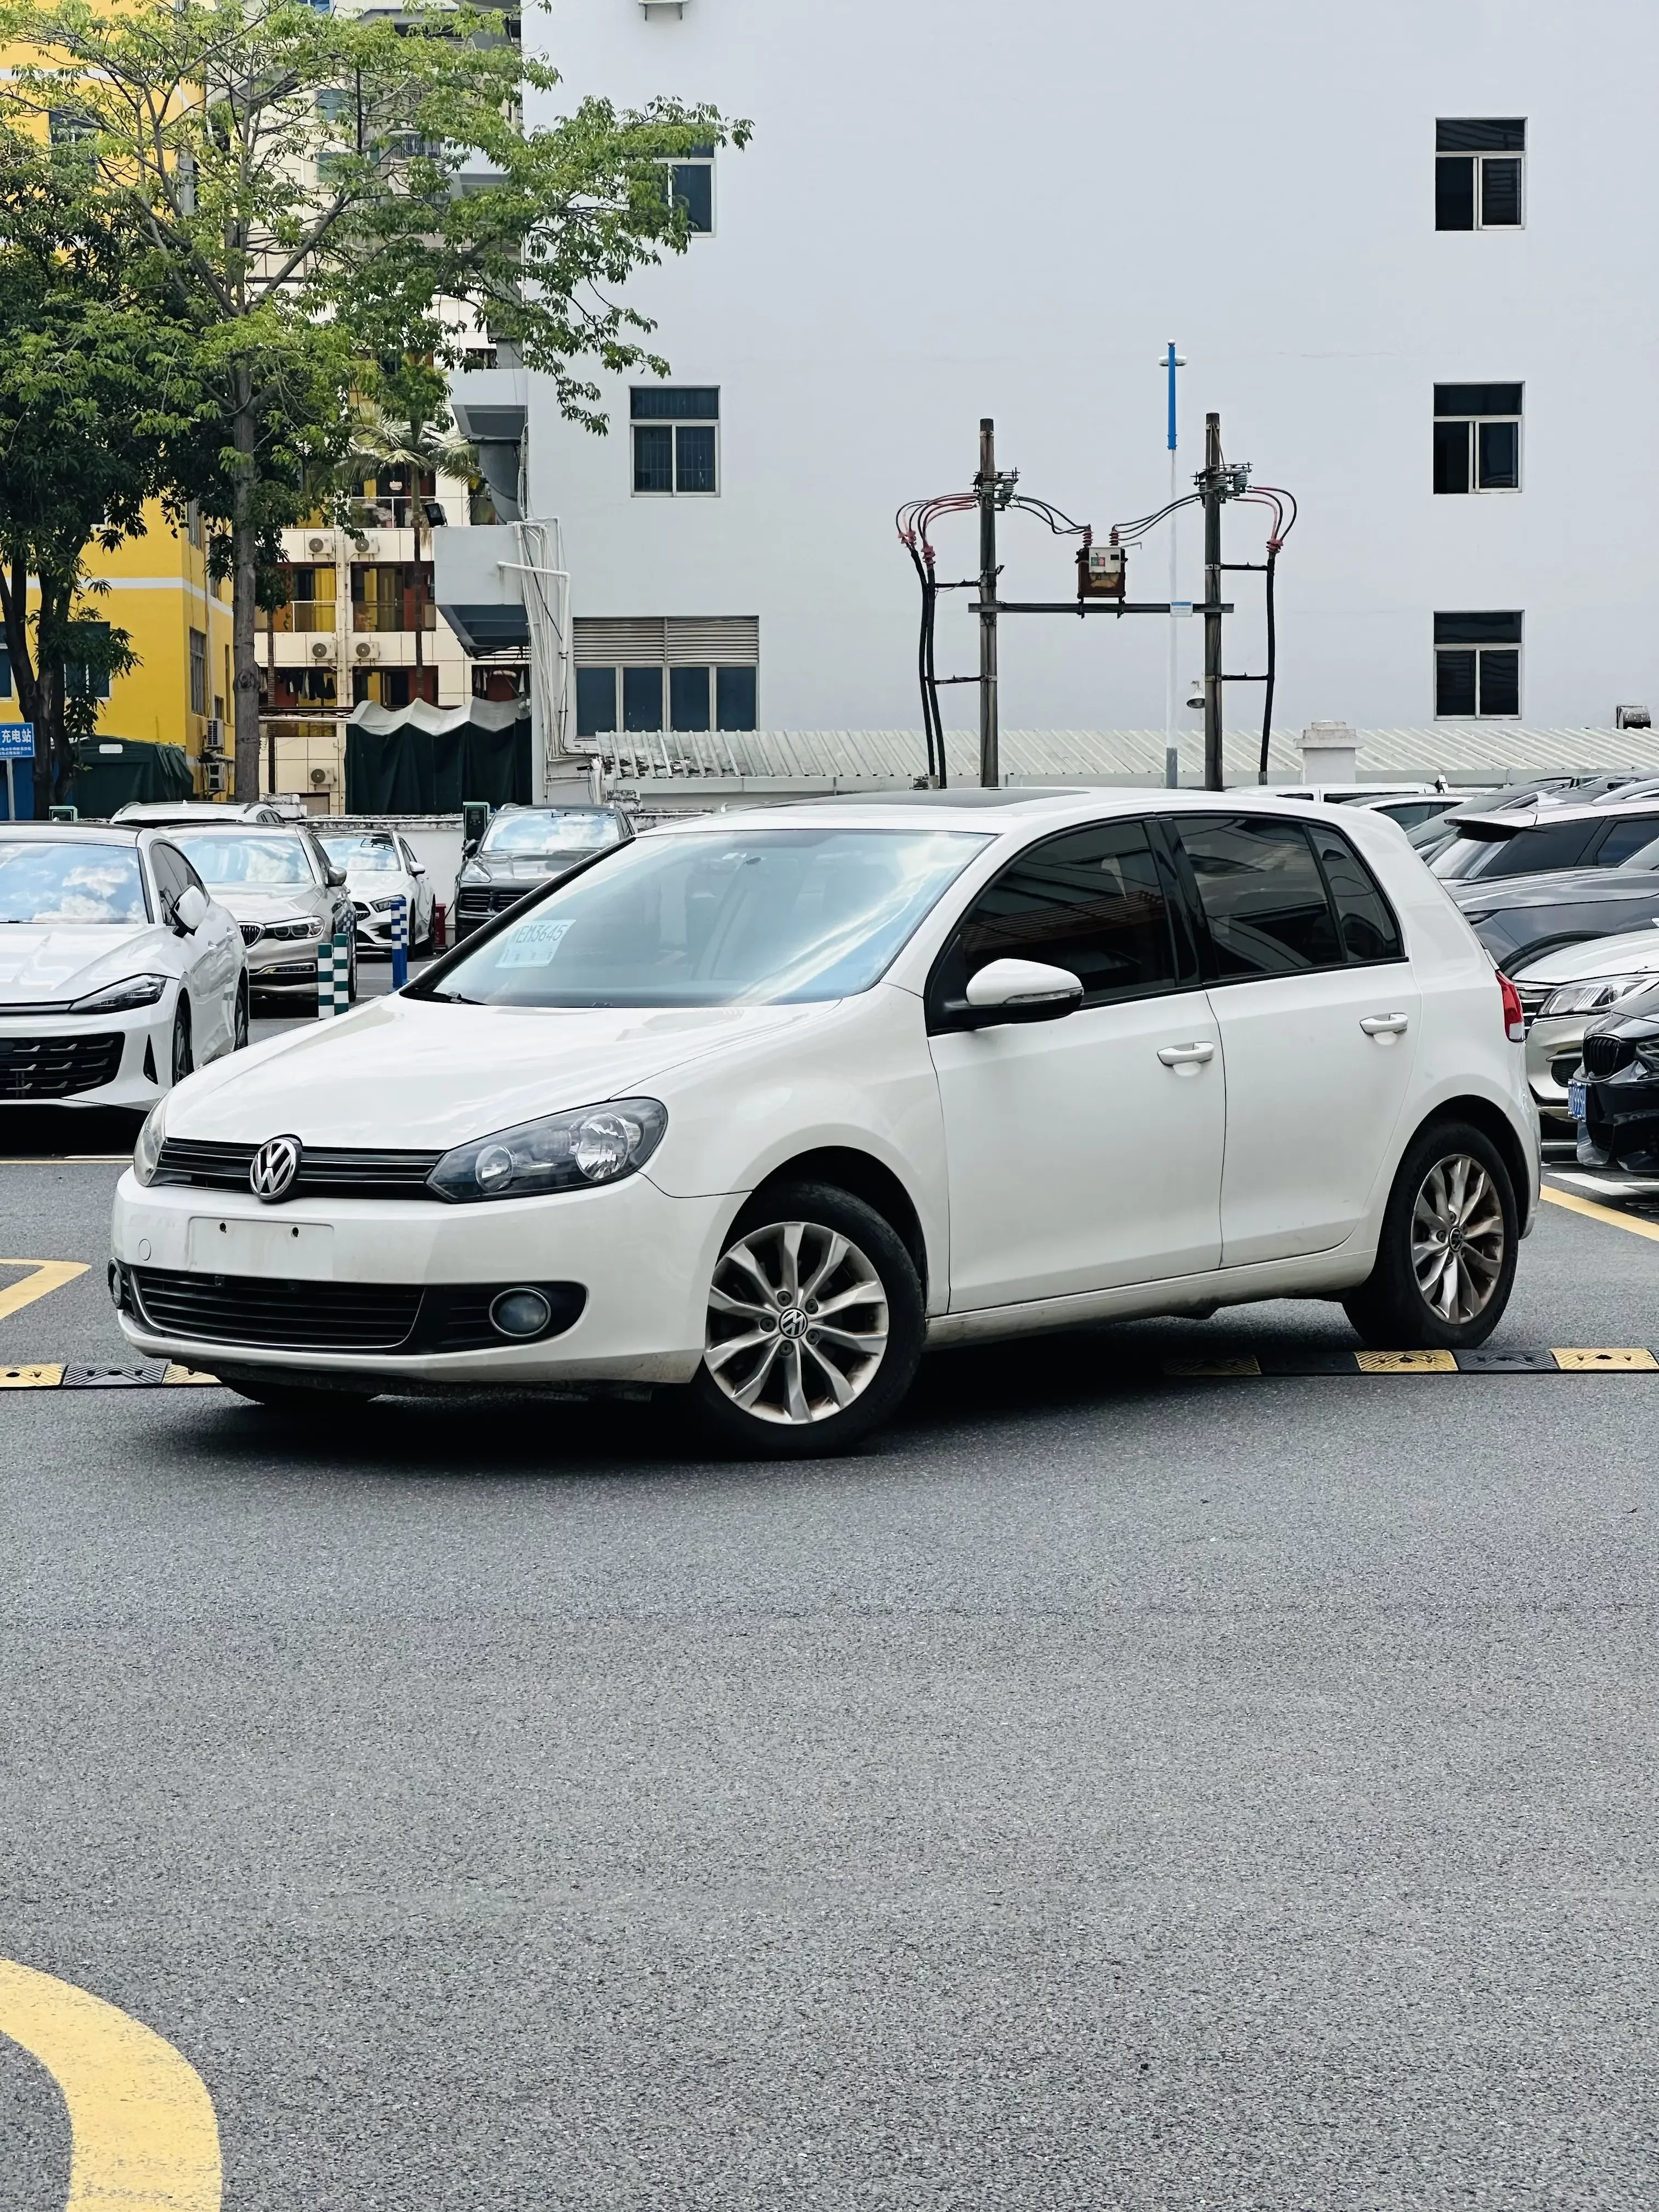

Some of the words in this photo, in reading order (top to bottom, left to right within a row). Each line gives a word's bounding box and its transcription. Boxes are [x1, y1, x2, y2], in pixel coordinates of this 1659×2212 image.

[1, 728, 32, 743] 充电站
[510, 924, 568, 944] EM3645
[251, 1140, 295, 1198] VW
